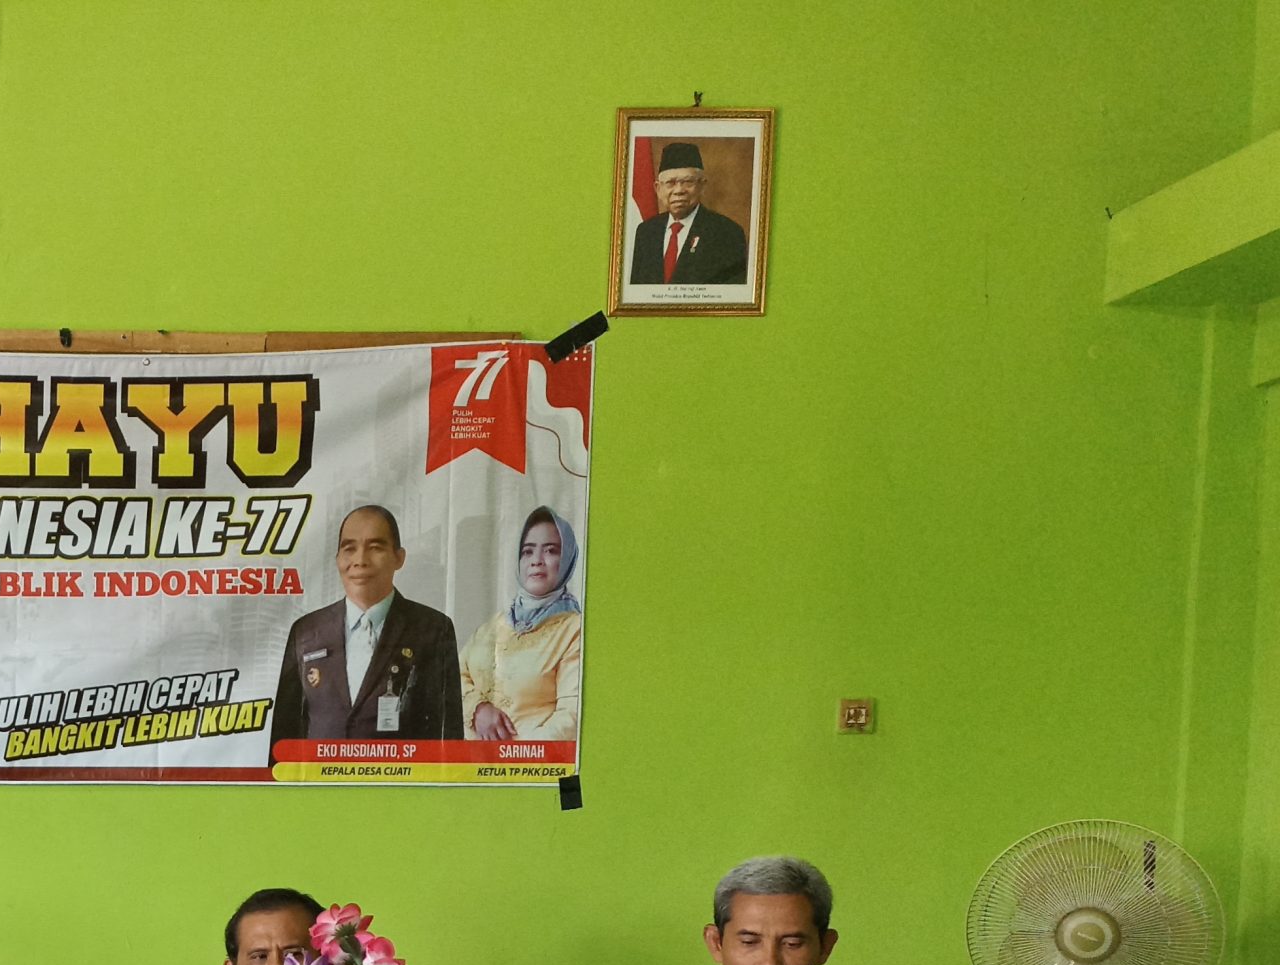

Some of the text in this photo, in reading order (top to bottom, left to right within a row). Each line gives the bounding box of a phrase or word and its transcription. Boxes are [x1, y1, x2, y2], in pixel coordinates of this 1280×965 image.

[453, 350, 510, 407] 77
[155, 494, 312, 558] KE-77
[93, 567, 305, 597] INDONESIA
[63, 680, 150, 722] LEBIH
[146, 669, 239, 710] CEPAT
[4, 698, 273, 761] BANGKIT LEBIH KUAT
[317, 743, 416, 759] EKO RUSDIANTO, SP
[499, 744, 545, 758] SARINAH
[321, 766, 412, 776] KEPALA DESA CIJATI
[477, 767, 566, 776] KETUA TP PKK DESA
